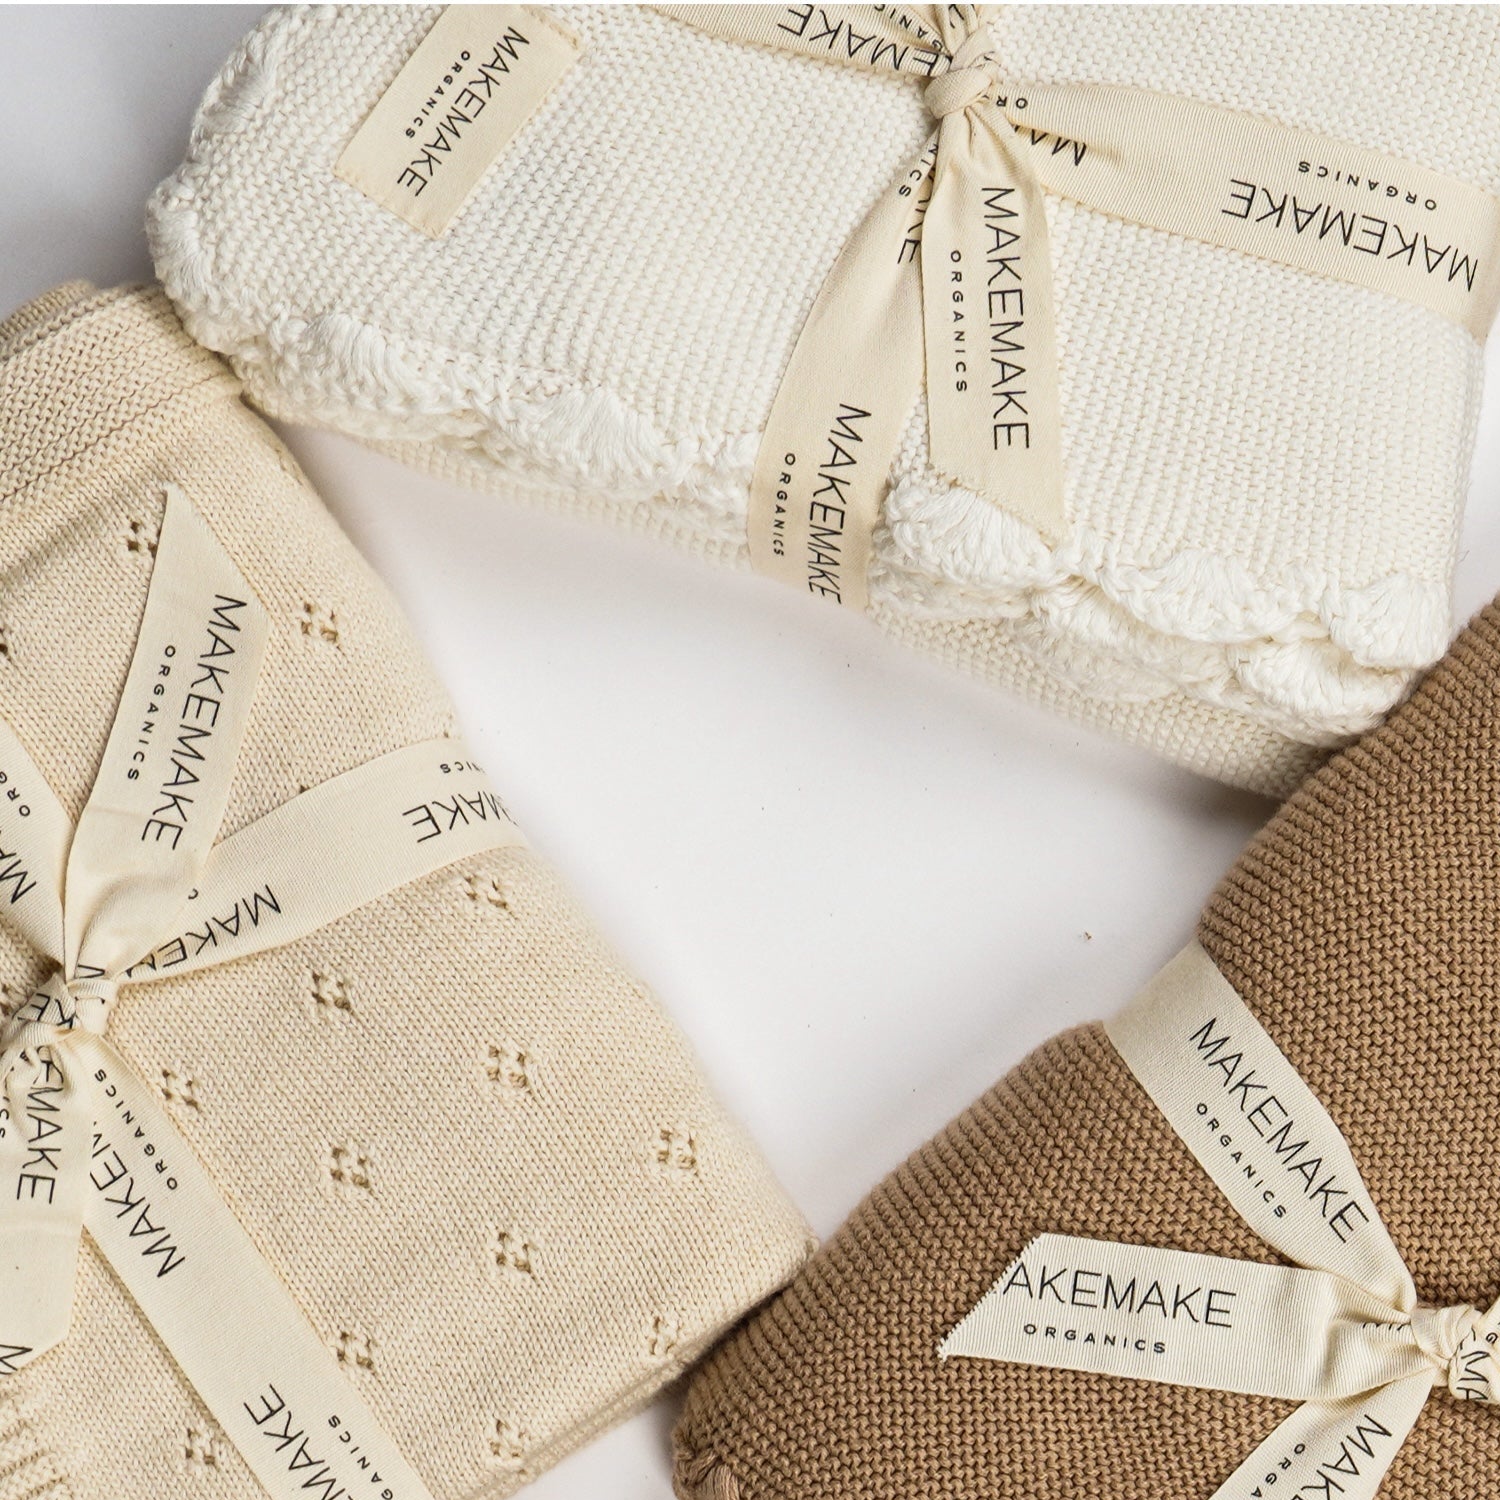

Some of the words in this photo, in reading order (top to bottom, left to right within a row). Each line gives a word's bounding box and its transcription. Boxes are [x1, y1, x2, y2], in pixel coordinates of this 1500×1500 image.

[405, 50, 470, 140] ORGANICS
[777, 4, 953, 76] EMAKE
[397, 26, 530, 196] MAKEMAKE
[1222, 179, 1478, 292] MAKEMAKE
[1298, 161, 1437, 211] ORGANICS
[950, 250, 967, 392] ORGANICS
[981, 187, 1030, 451] MAKEMAKE
[773, 452, 796, 557] ORGANICS
[808, 403, 872, 604] MAKEMAKE
[127, 645, 176, 781] ORGANICS
[142, 594, 247, 850] MAKEMAKE
[95, 1068, 178, 1190] ORGANICS
[1190, 1017, 1369, 1243] MAKEMAKE
[1196, 1103, 1287, 1218] ORGANICS
[1003, 1262, 1237, 1328] AKEMAKE
[1024, 1323, 1166, 1354] ORGANICS
